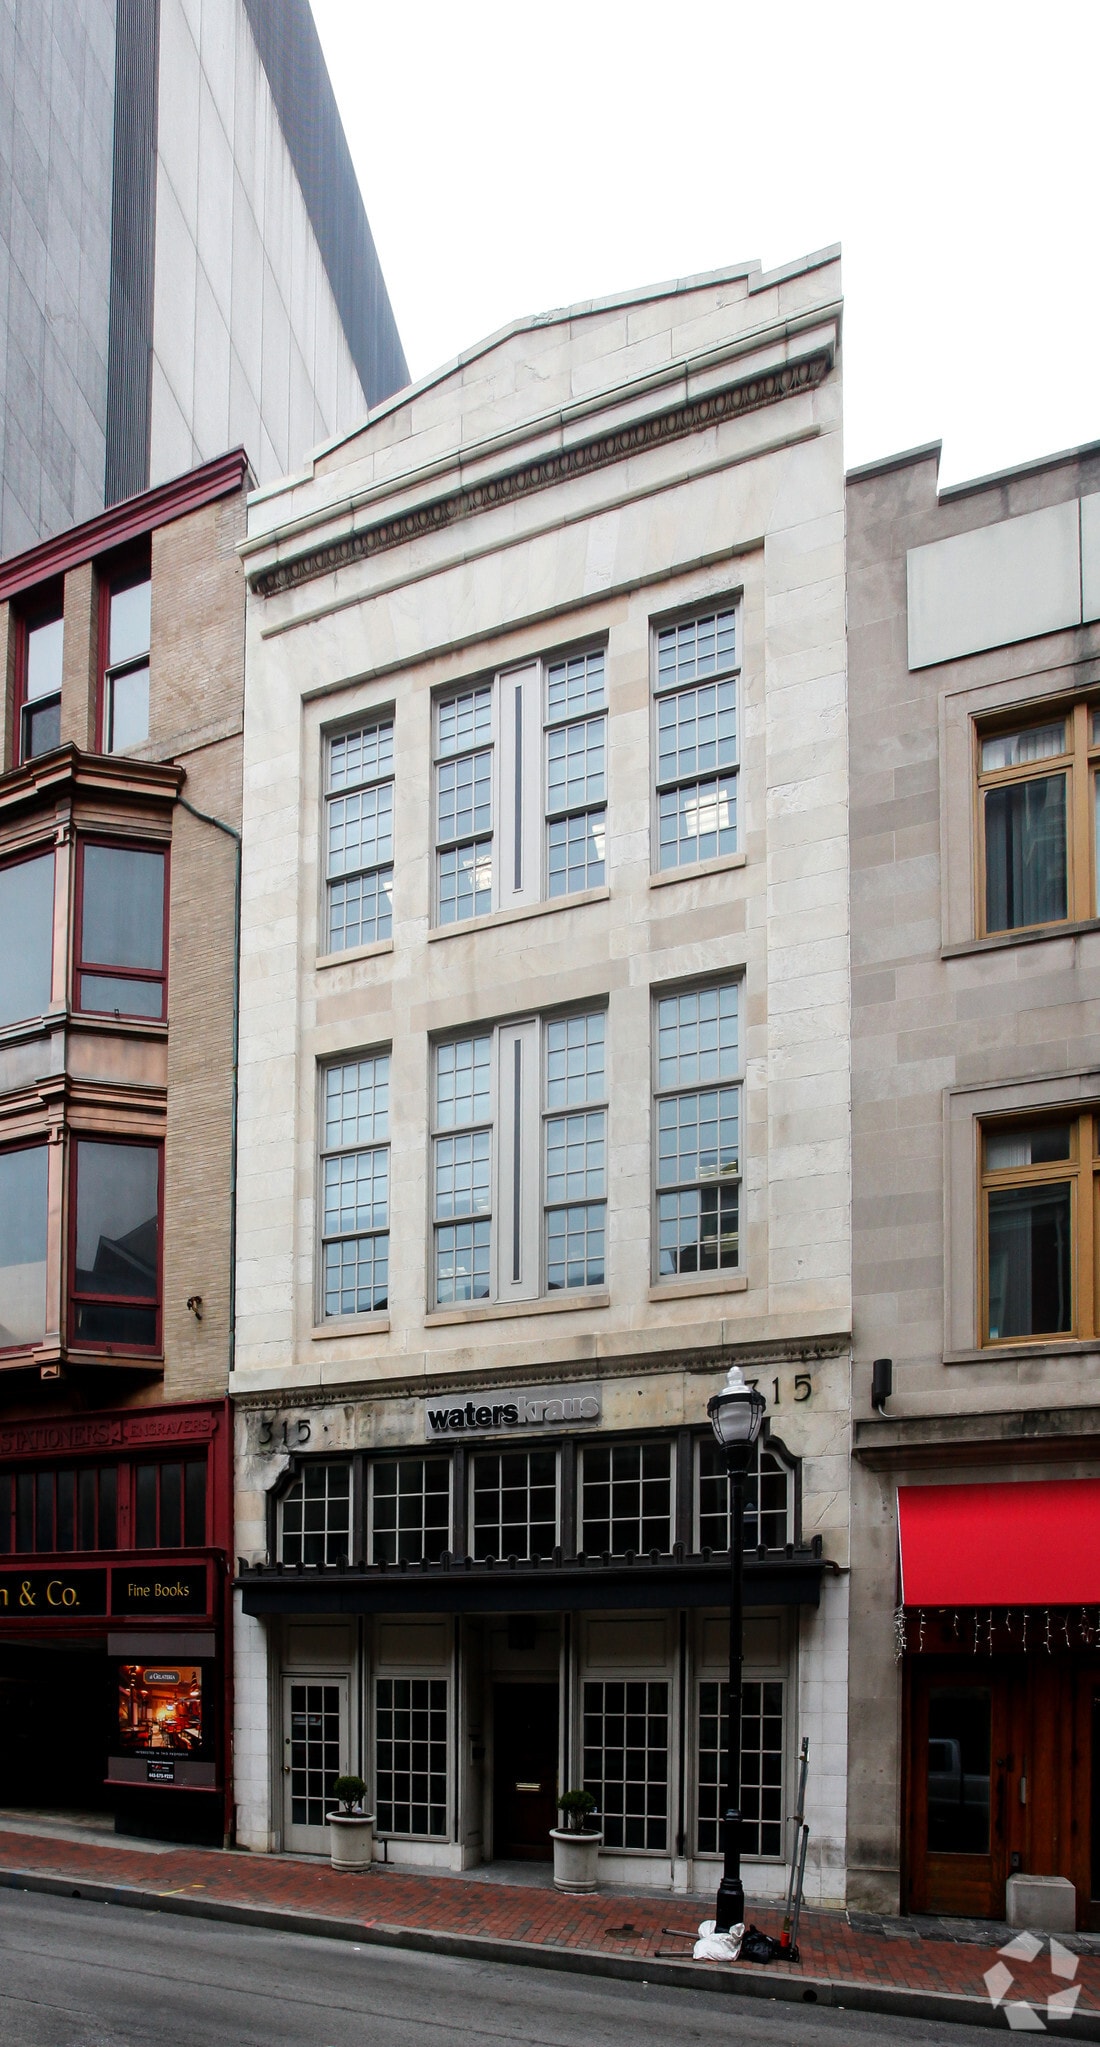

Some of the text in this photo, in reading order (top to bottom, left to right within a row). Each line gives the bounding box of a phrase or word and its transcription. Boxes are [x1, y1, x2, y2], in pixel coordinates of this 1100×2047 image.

[427, 1396, 600, 1430] waterskraus
[0, 1424, 110, 1453] STATIONERS
[129, 1418, 211, 1438] ENGRAVERS
[258, 1419, 311, 1445] 315
[19, 1580, 37, 1607] &
[46, 1580, 81, 1607] Co.
[128, 1581, 190, 1597] Fine Books
